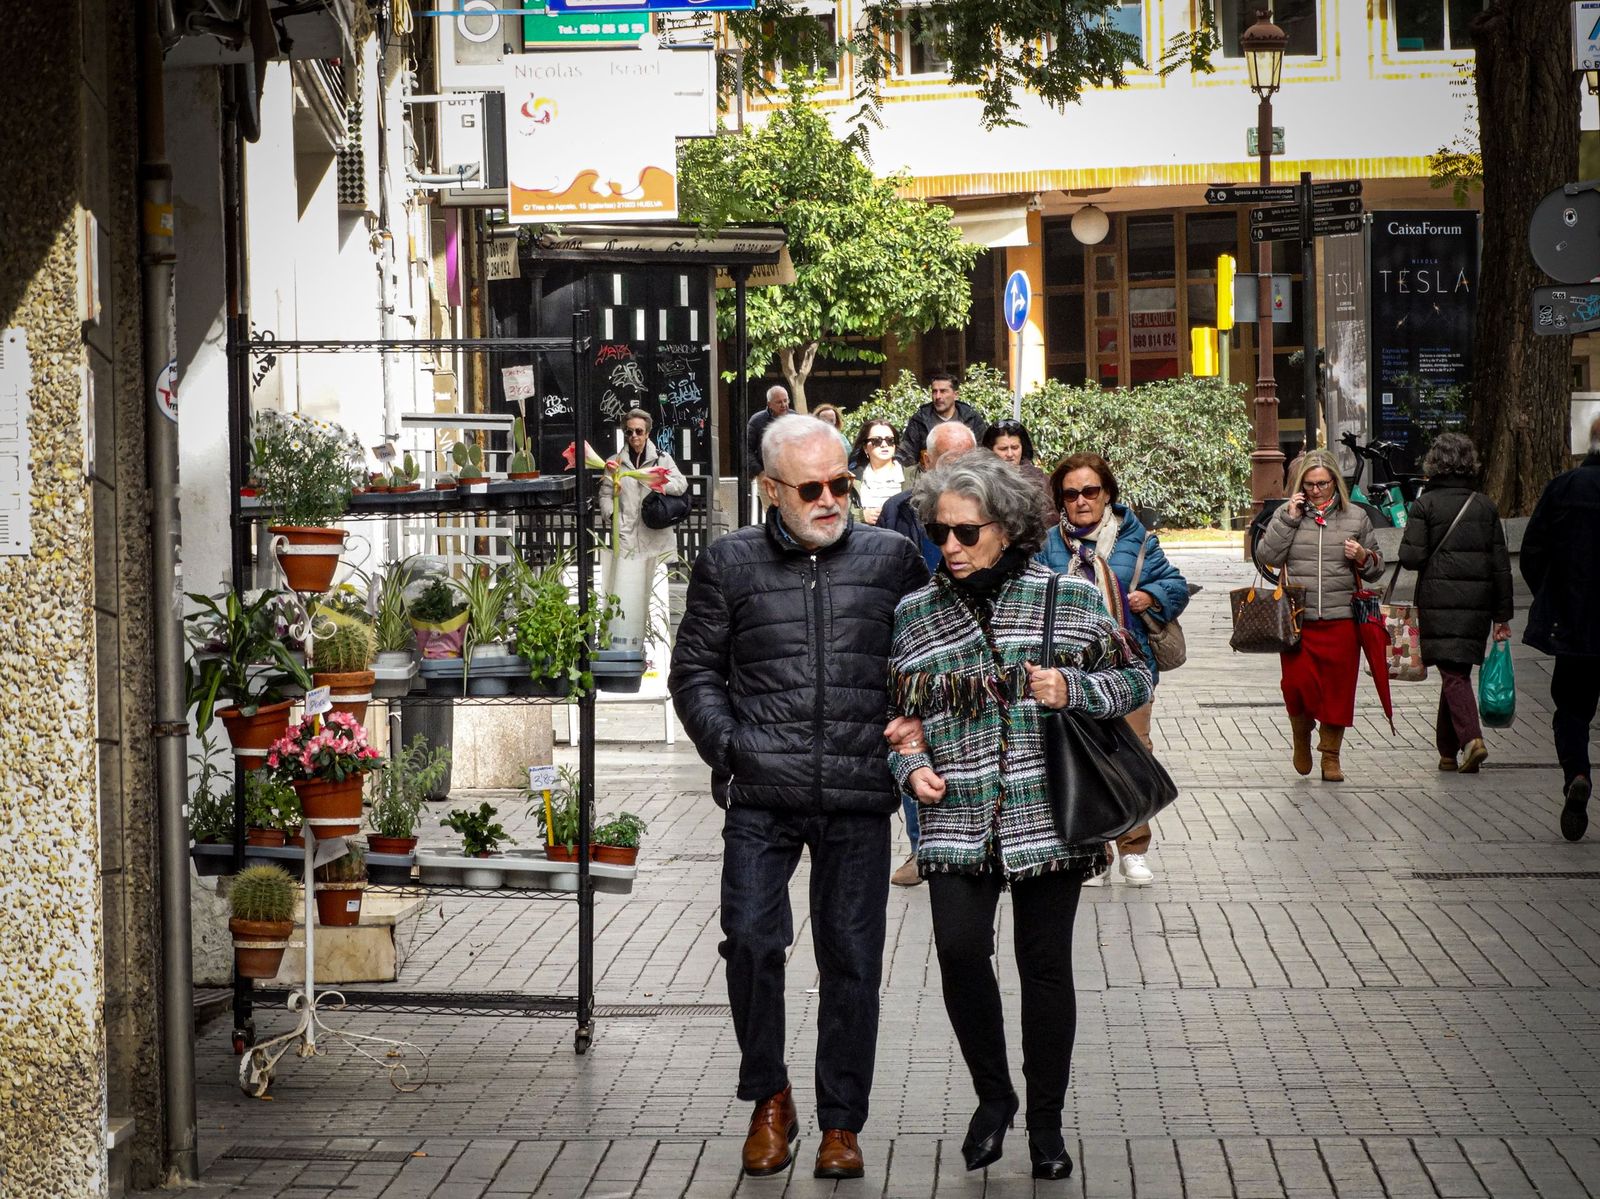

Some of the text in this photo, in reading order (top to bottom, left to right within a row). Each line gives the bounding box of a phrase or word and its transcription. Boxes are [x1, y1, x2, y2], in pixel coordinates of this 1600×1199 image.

[610, 61, 660, 75] Israel
[1388, 221, 1462, 235] CaixaForum
[1328, 272, 1362, 296] TESLA
[1379, 268, 1469, 293] TESLA
[1133, 312, 1175, 326] SE ALQUILA
